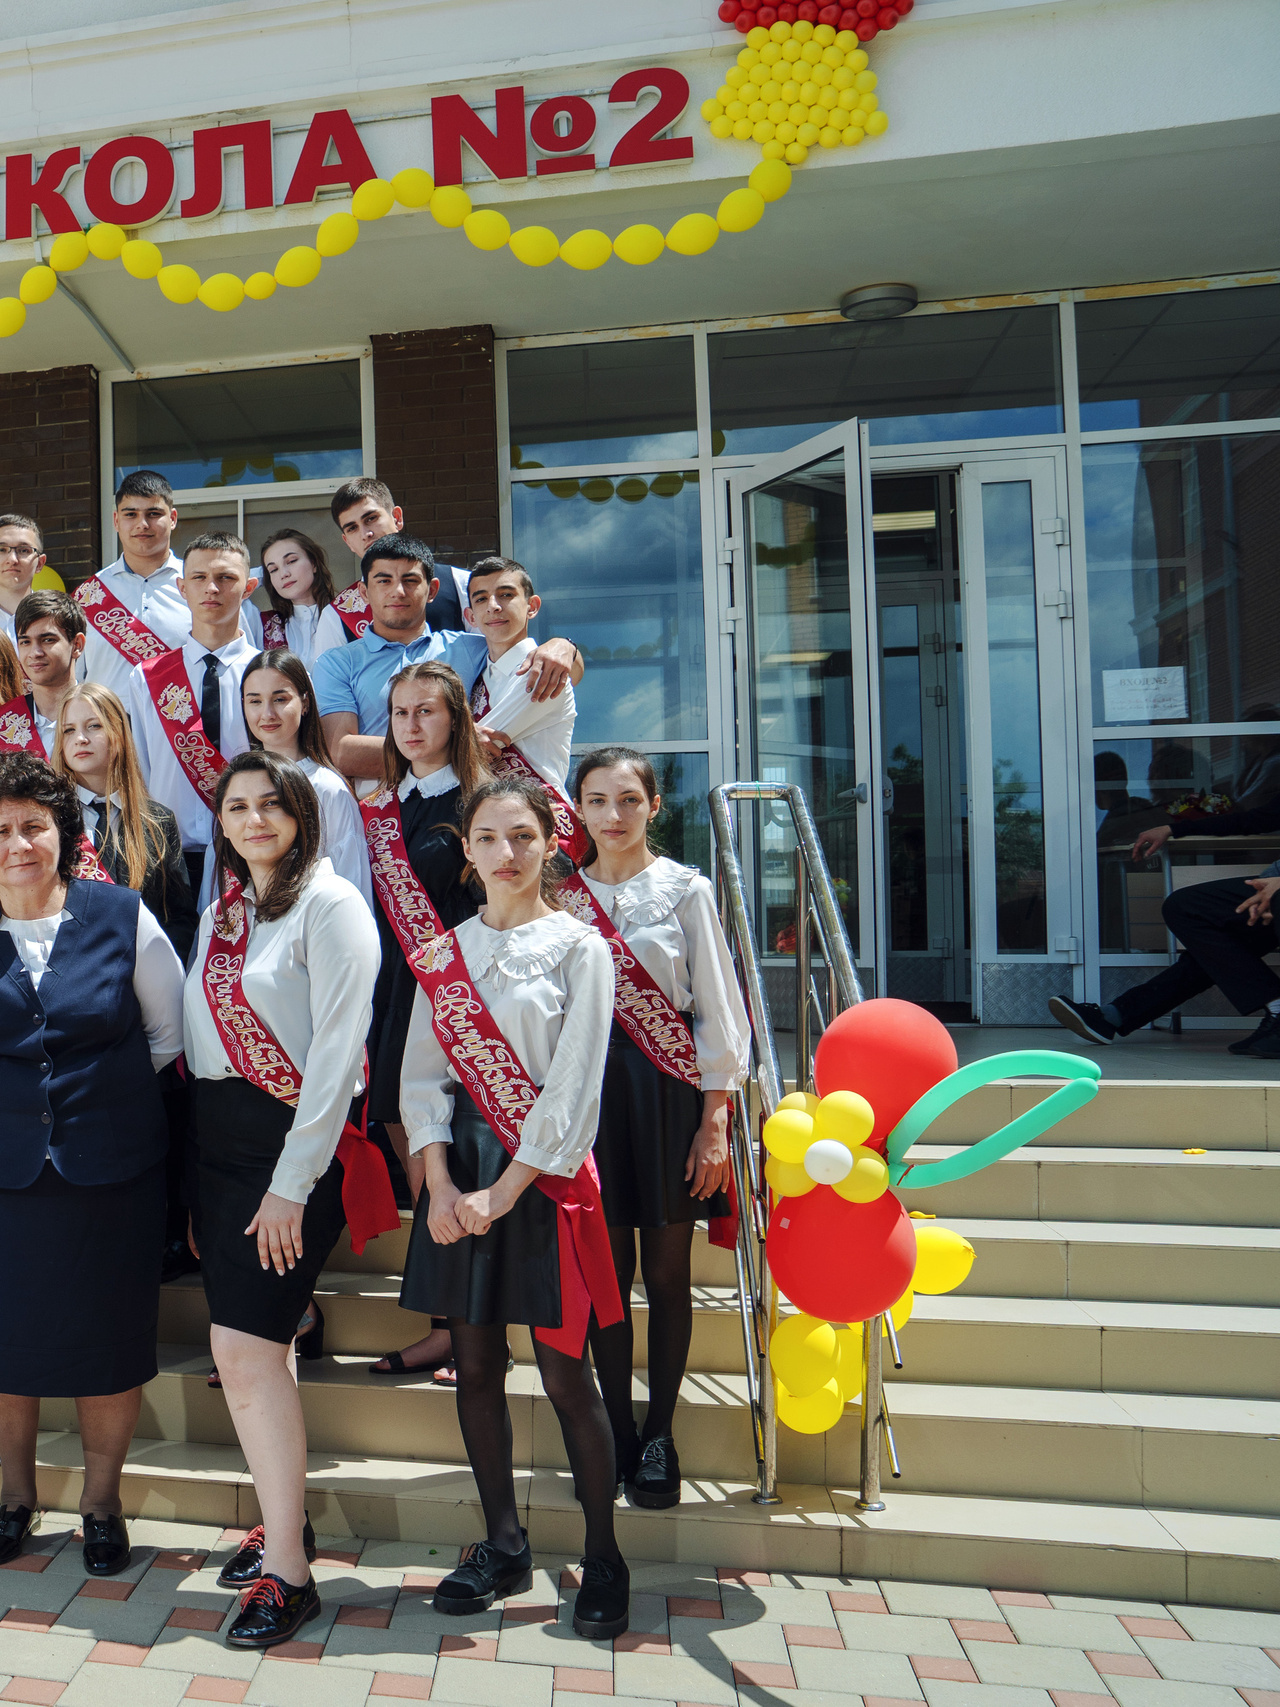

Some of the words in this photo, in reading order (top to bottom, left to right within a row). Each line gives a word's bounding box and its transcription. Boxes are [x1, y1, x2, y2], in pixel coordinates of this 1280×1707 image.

[431, 67, 694, 186] №2
[366, 817, 435, 922] Выпускник
[206, 953, 292, 1079] Выпускник
[434, 980, 538, 1118] Выпускник
